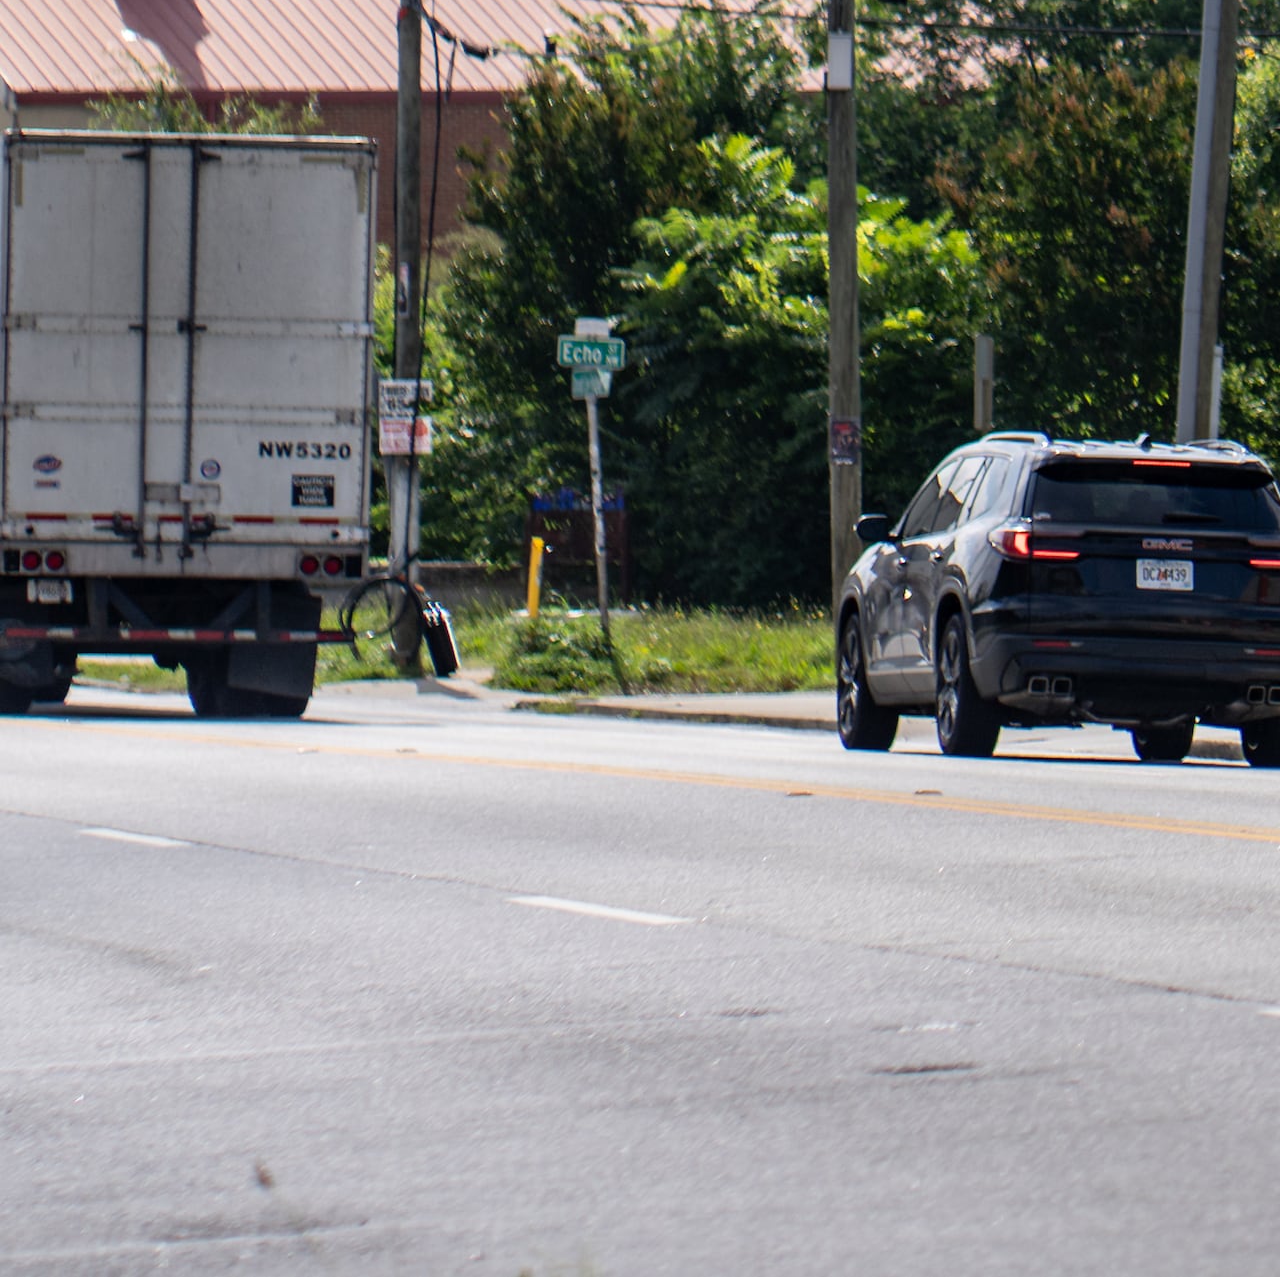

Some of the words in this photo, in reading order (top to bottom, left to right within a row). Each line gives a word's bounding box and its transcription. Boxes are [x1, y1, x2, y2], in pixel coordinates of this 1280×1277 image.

[562, 342, 603, 364] Echo
[259, 441, 351, 459] NW5320
[1142, 538, 1193, 551] GMC
